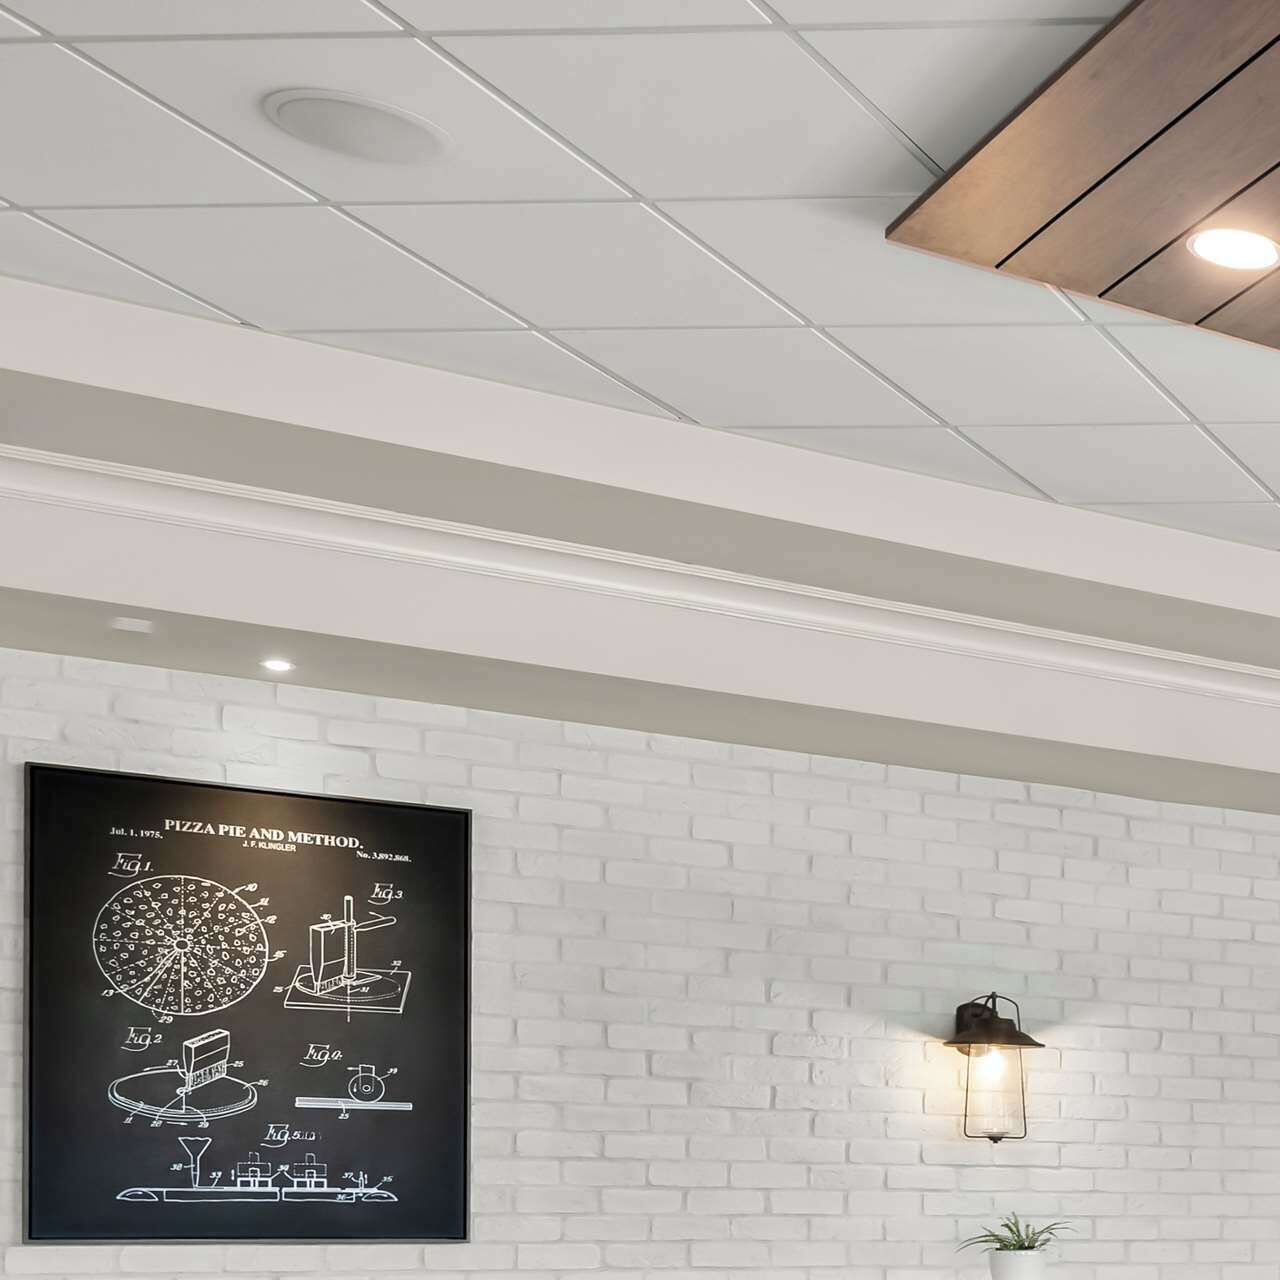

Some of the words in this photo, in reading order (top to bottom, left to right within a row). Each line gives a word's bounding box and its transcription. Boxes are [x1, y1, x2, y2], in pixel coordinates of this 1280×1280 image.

[110, 827, 127, 836] Jul.
[164, 819, 216, 835] PIZZA
[218, 824, 247, 838] PIE
[249, 827, 285, 841] AND
[288, 831, 364, 849] METHOD.
[242, 840, 249, 848] J.
[258, 842, 296, 852] KLINGLER
[356, 850, 371, 859] No.
[158, 1015, 174, 1024] 29
